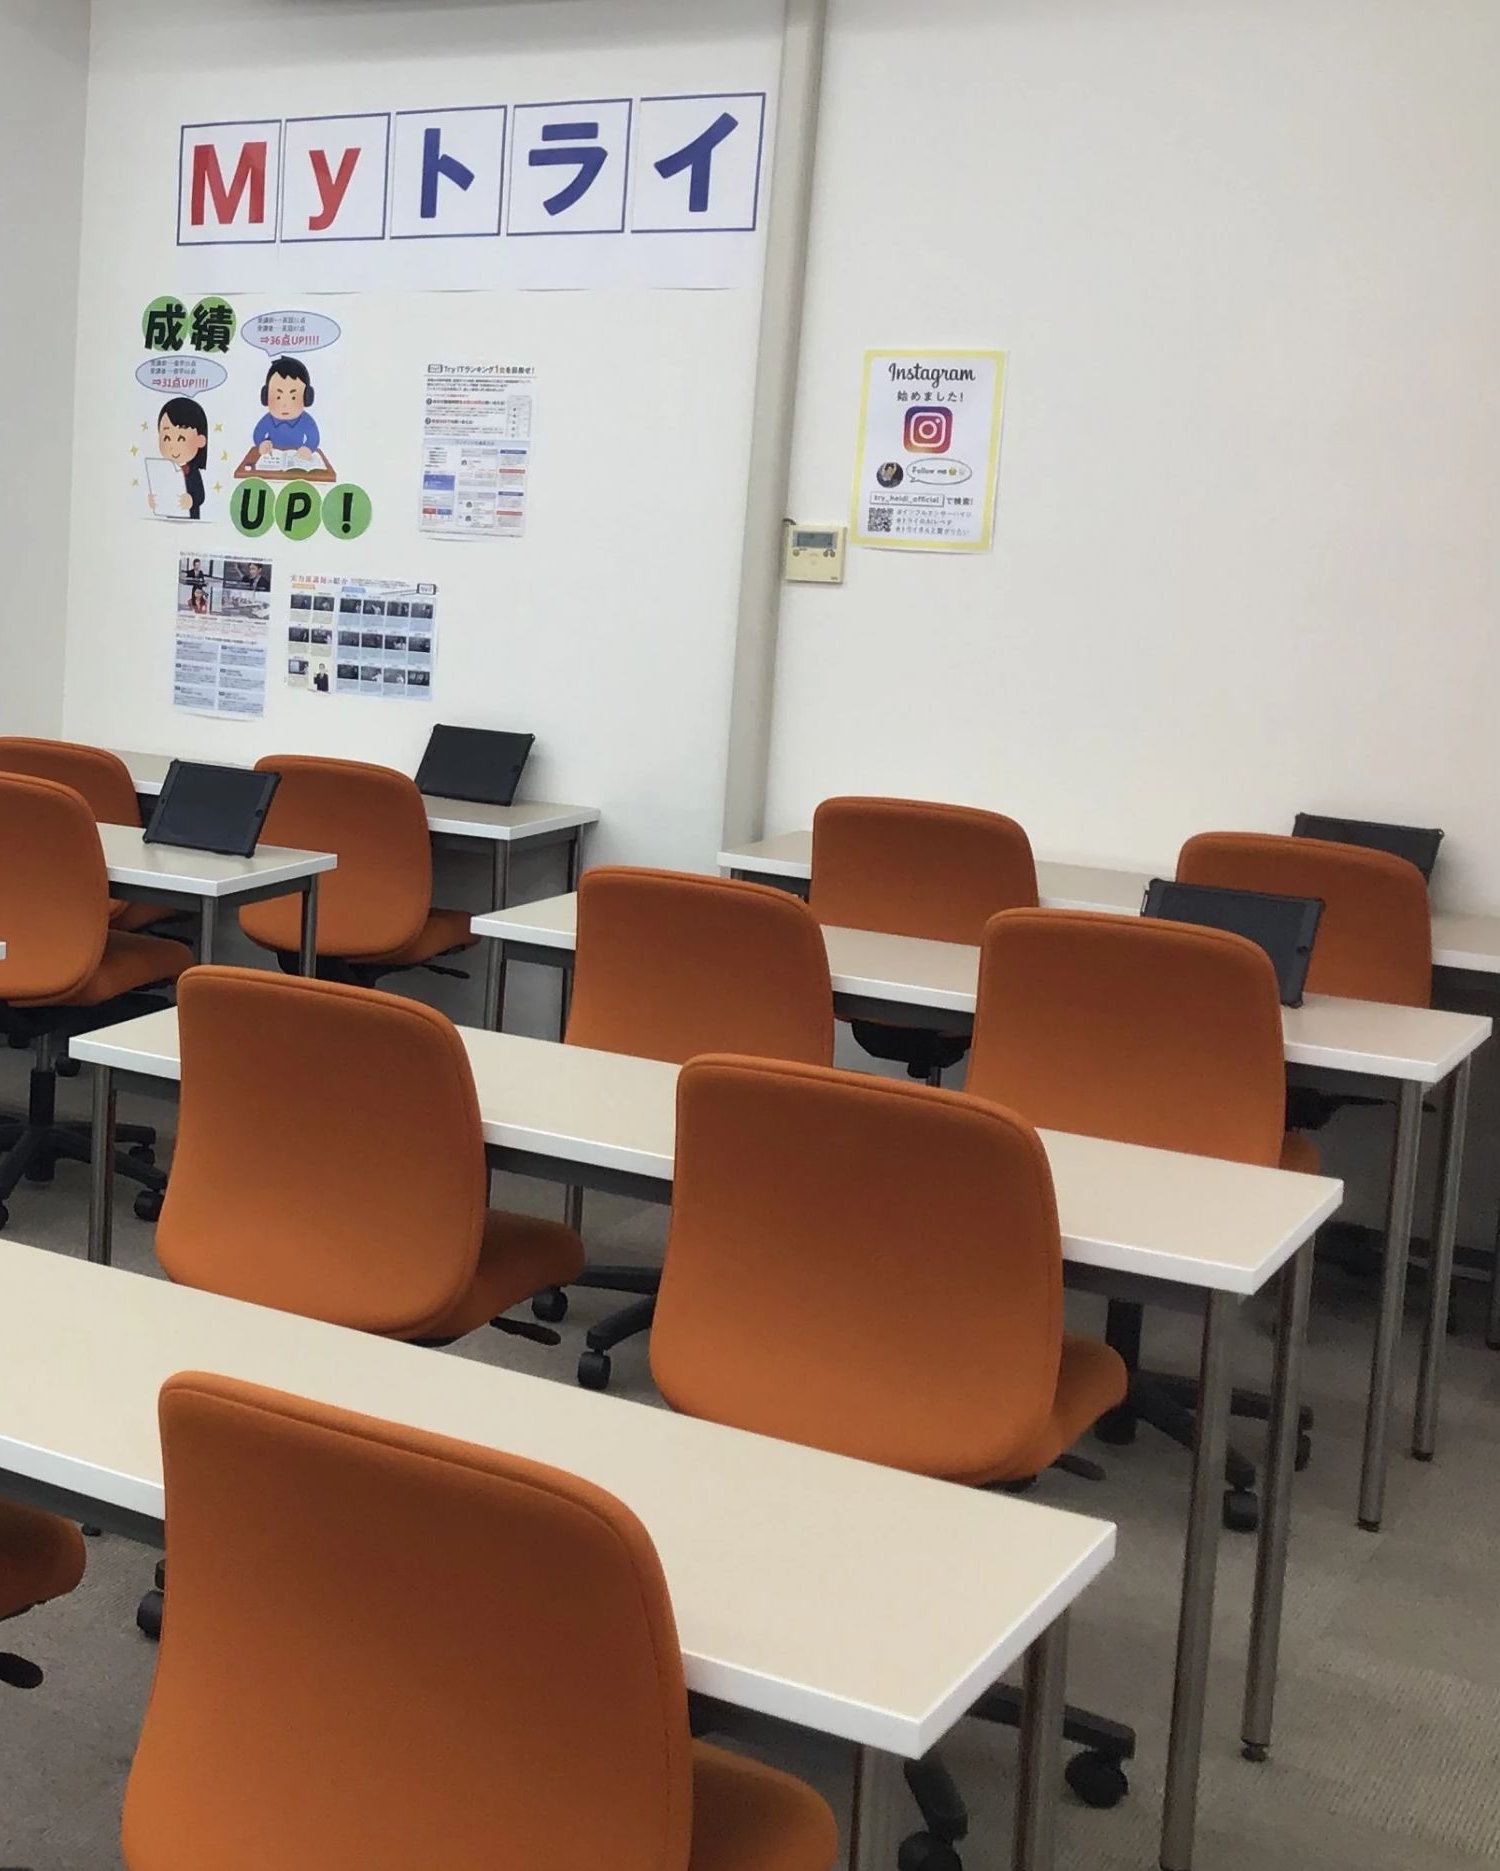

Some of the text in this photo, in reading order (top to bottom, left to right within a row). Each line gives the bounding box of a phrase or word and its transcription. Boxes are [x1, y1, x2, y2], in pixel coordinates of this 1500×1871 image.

[144, 303, 234, 353] 成績
[888, 362, 976, 388] Instagram
[897, 390, 964, 403] 始めました!
[911, 466, 935, 475] Follow
[240, 488, 354, 534] UP!
